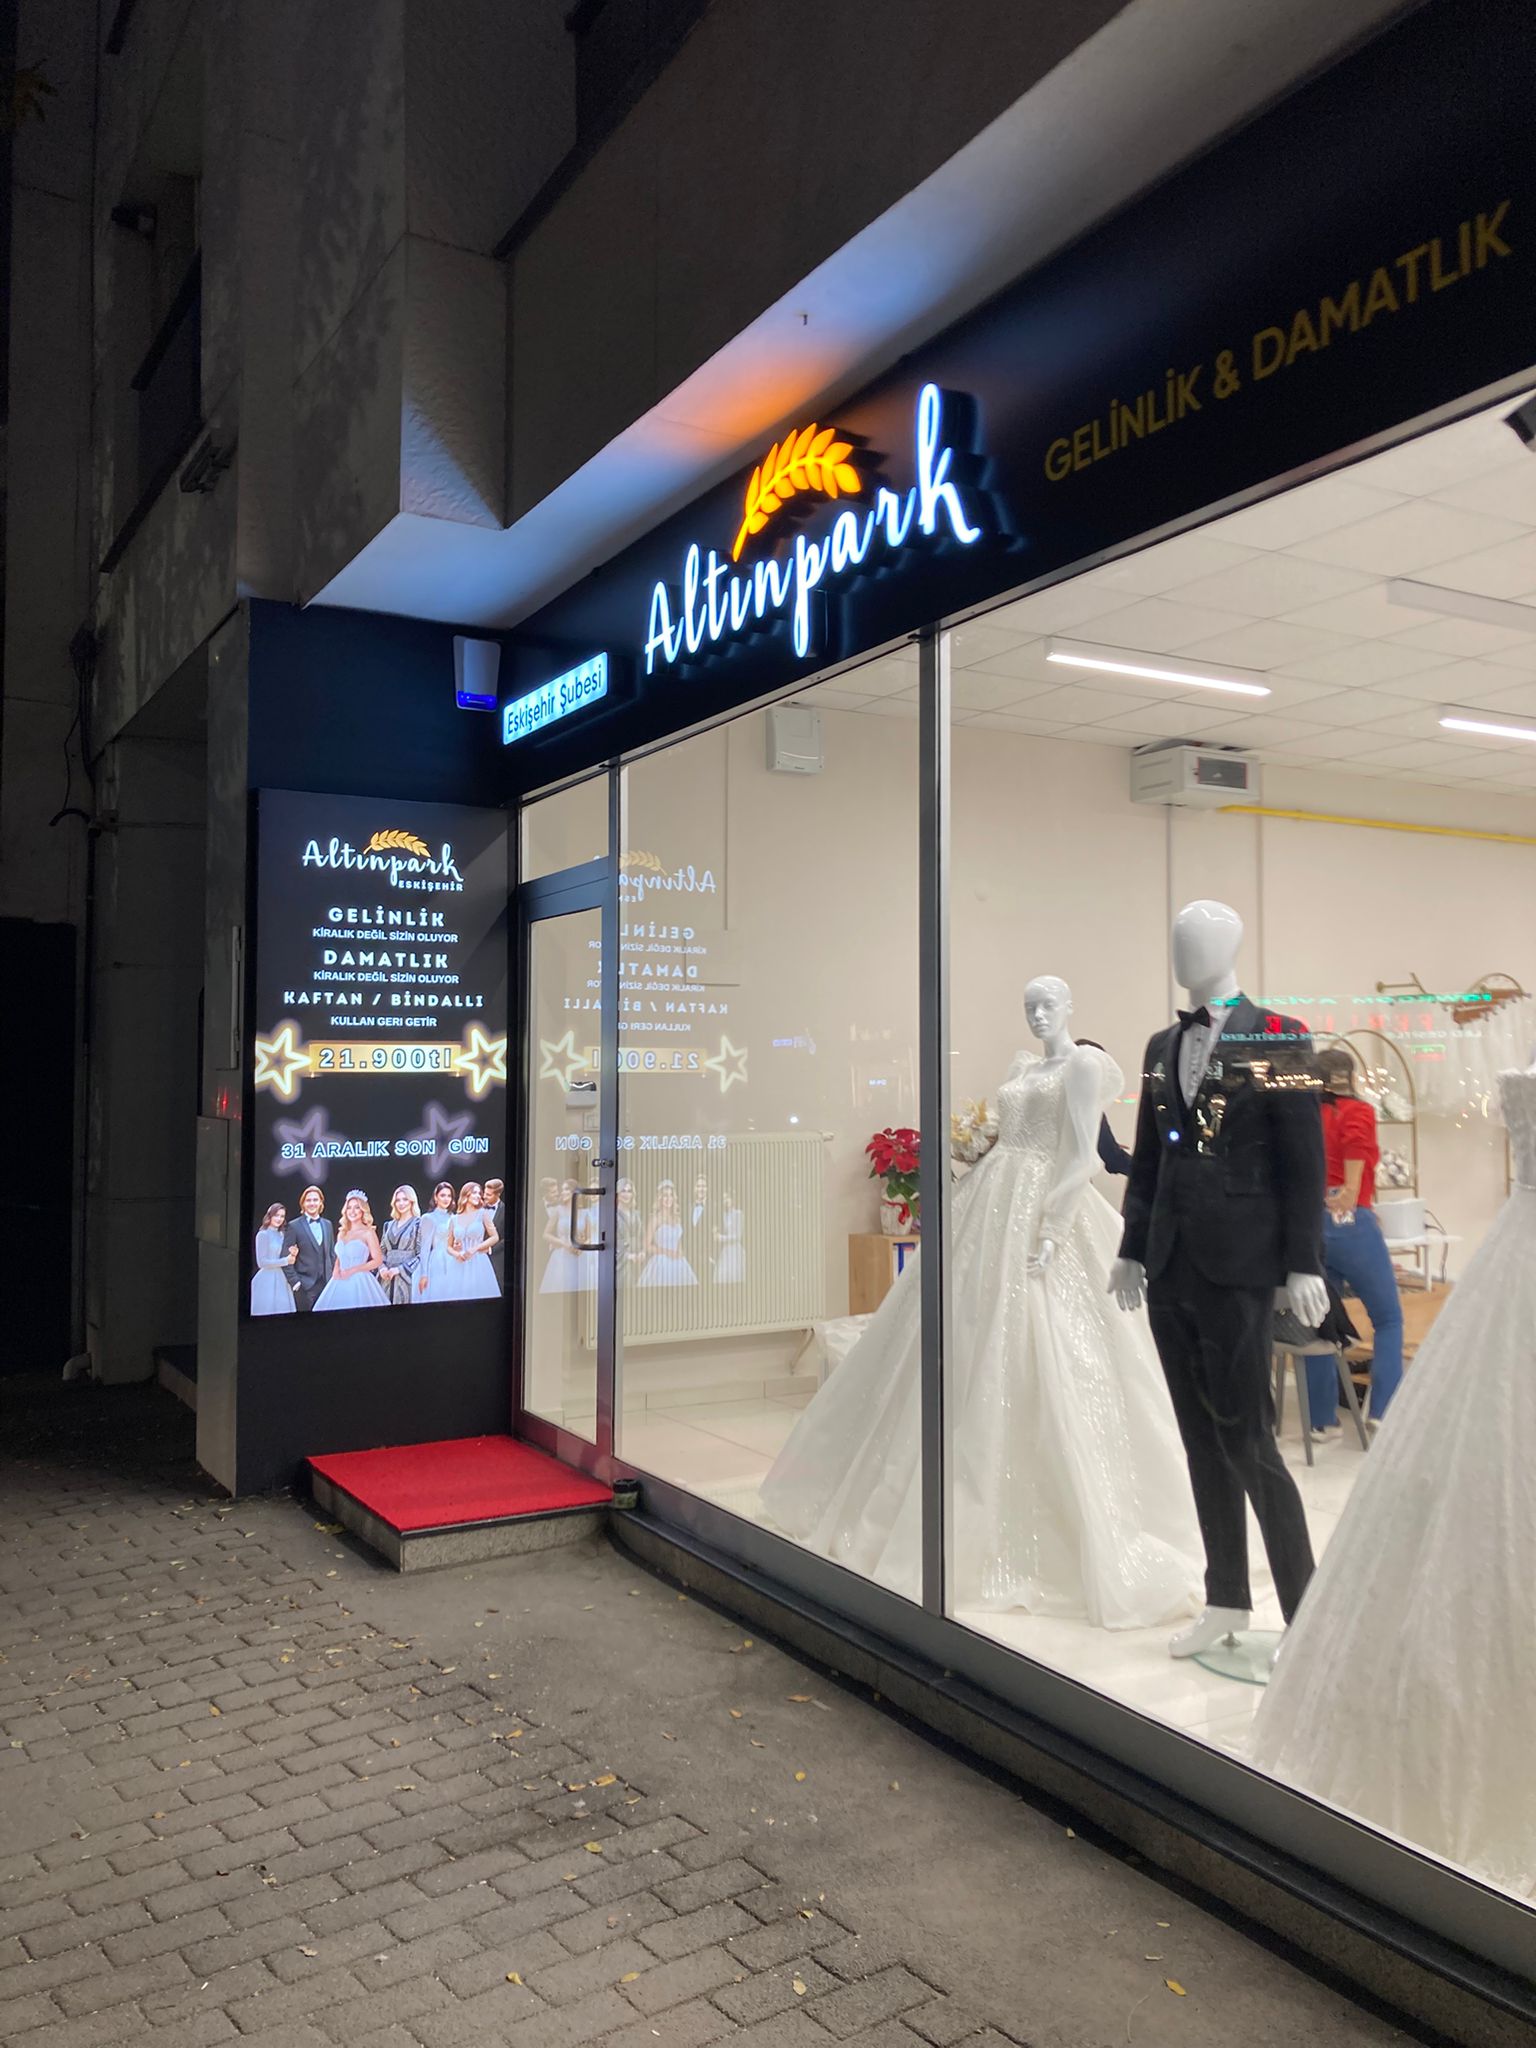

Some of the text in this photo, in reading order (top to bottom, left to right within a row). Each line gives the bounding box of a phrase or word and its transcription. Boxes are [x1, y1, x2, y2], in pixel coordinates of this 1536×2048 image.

[1044, 200, 1513, 481] GELİNLİK & DAMATLIK
[507, 663, 602, 731] Eskişehir Şubesi
[398, 879, 464, 892] ESKİŞEHİR
[328, 905, 445, 927] GELİNLİK
[312, 926, 459, 943] KİRALIK DEĞİL SİZİN OLUYOR
[323, 949, 448, 969] DAMATLIK
[313, 969, 460, 984] KİRALIK DEĞİL SİZİN OLUYOR
[284, 990, 484, 1008] KAFTAN / BİNDALLI
[330, 1016, 375, 1026] KULLAN
[405, 1016, 438, 1027] GETİR
[281, 1136, 489, 1158] 31 ARALIK SON GÜN
